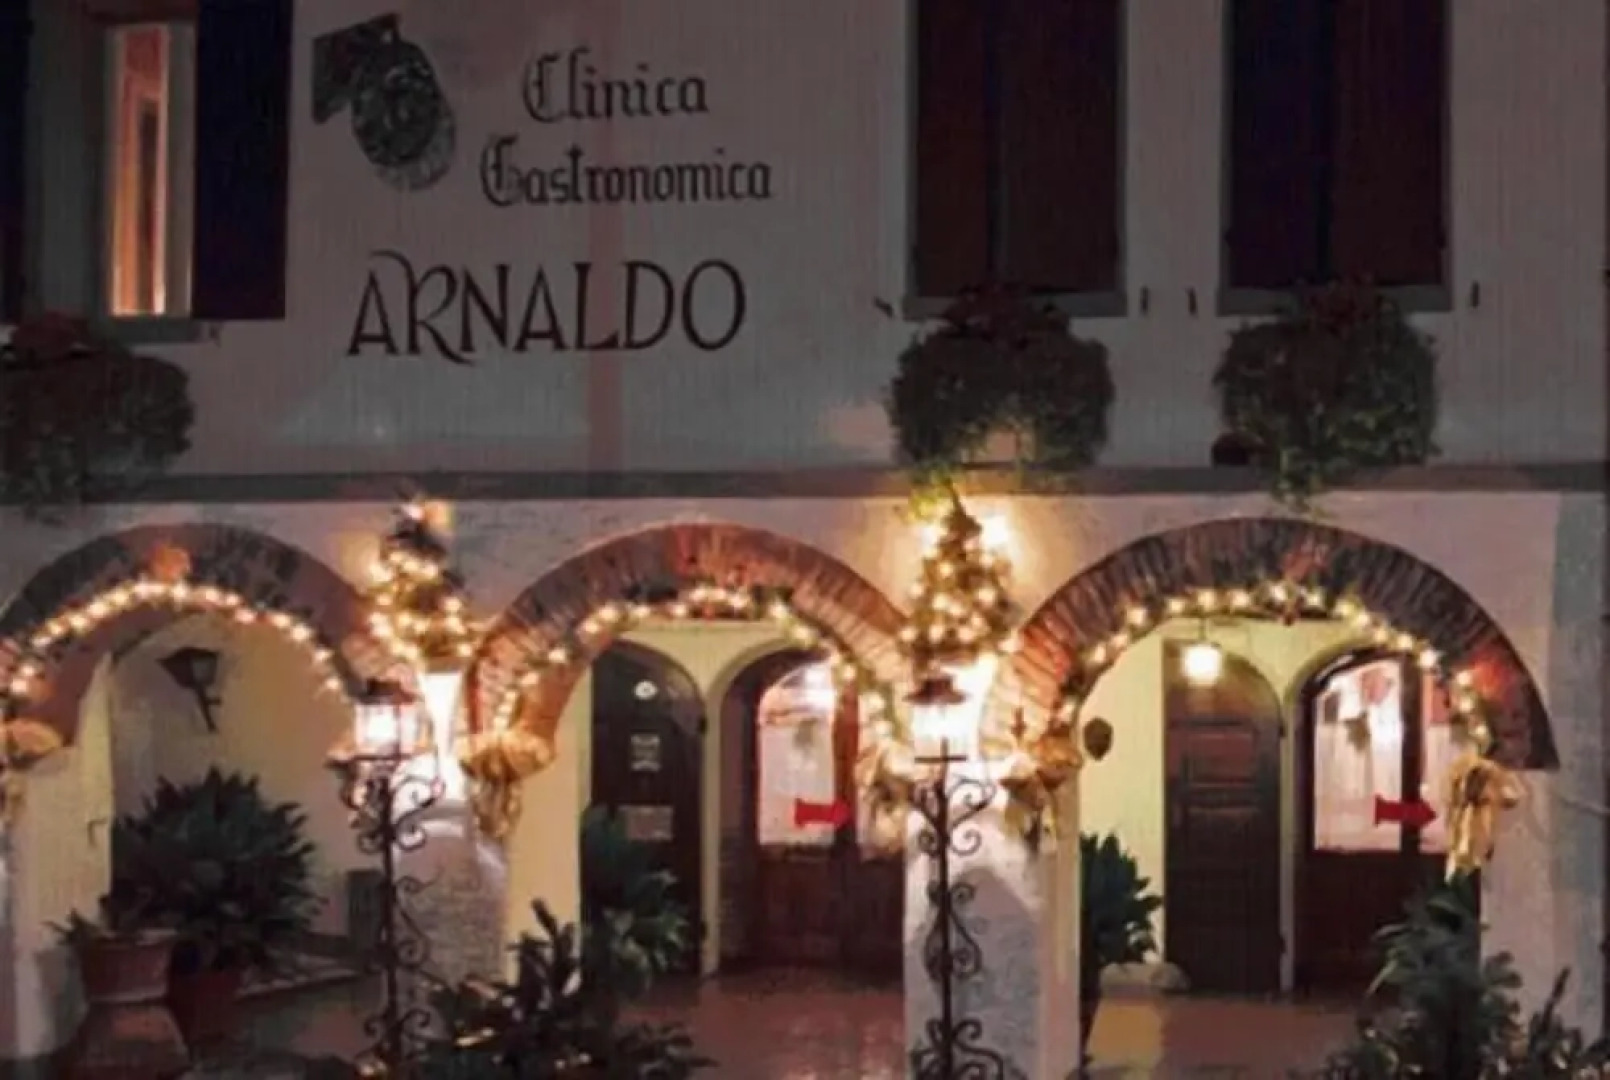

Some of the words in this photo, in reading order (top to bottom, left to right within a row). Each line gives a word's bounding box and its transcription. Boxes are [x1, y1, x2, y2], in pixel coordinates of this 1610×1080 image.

[522, 46, 709, 123] Clinica
[480, 133, 772, 207] Gastronomica
[346, 250, 747, 366] ARNALDO
